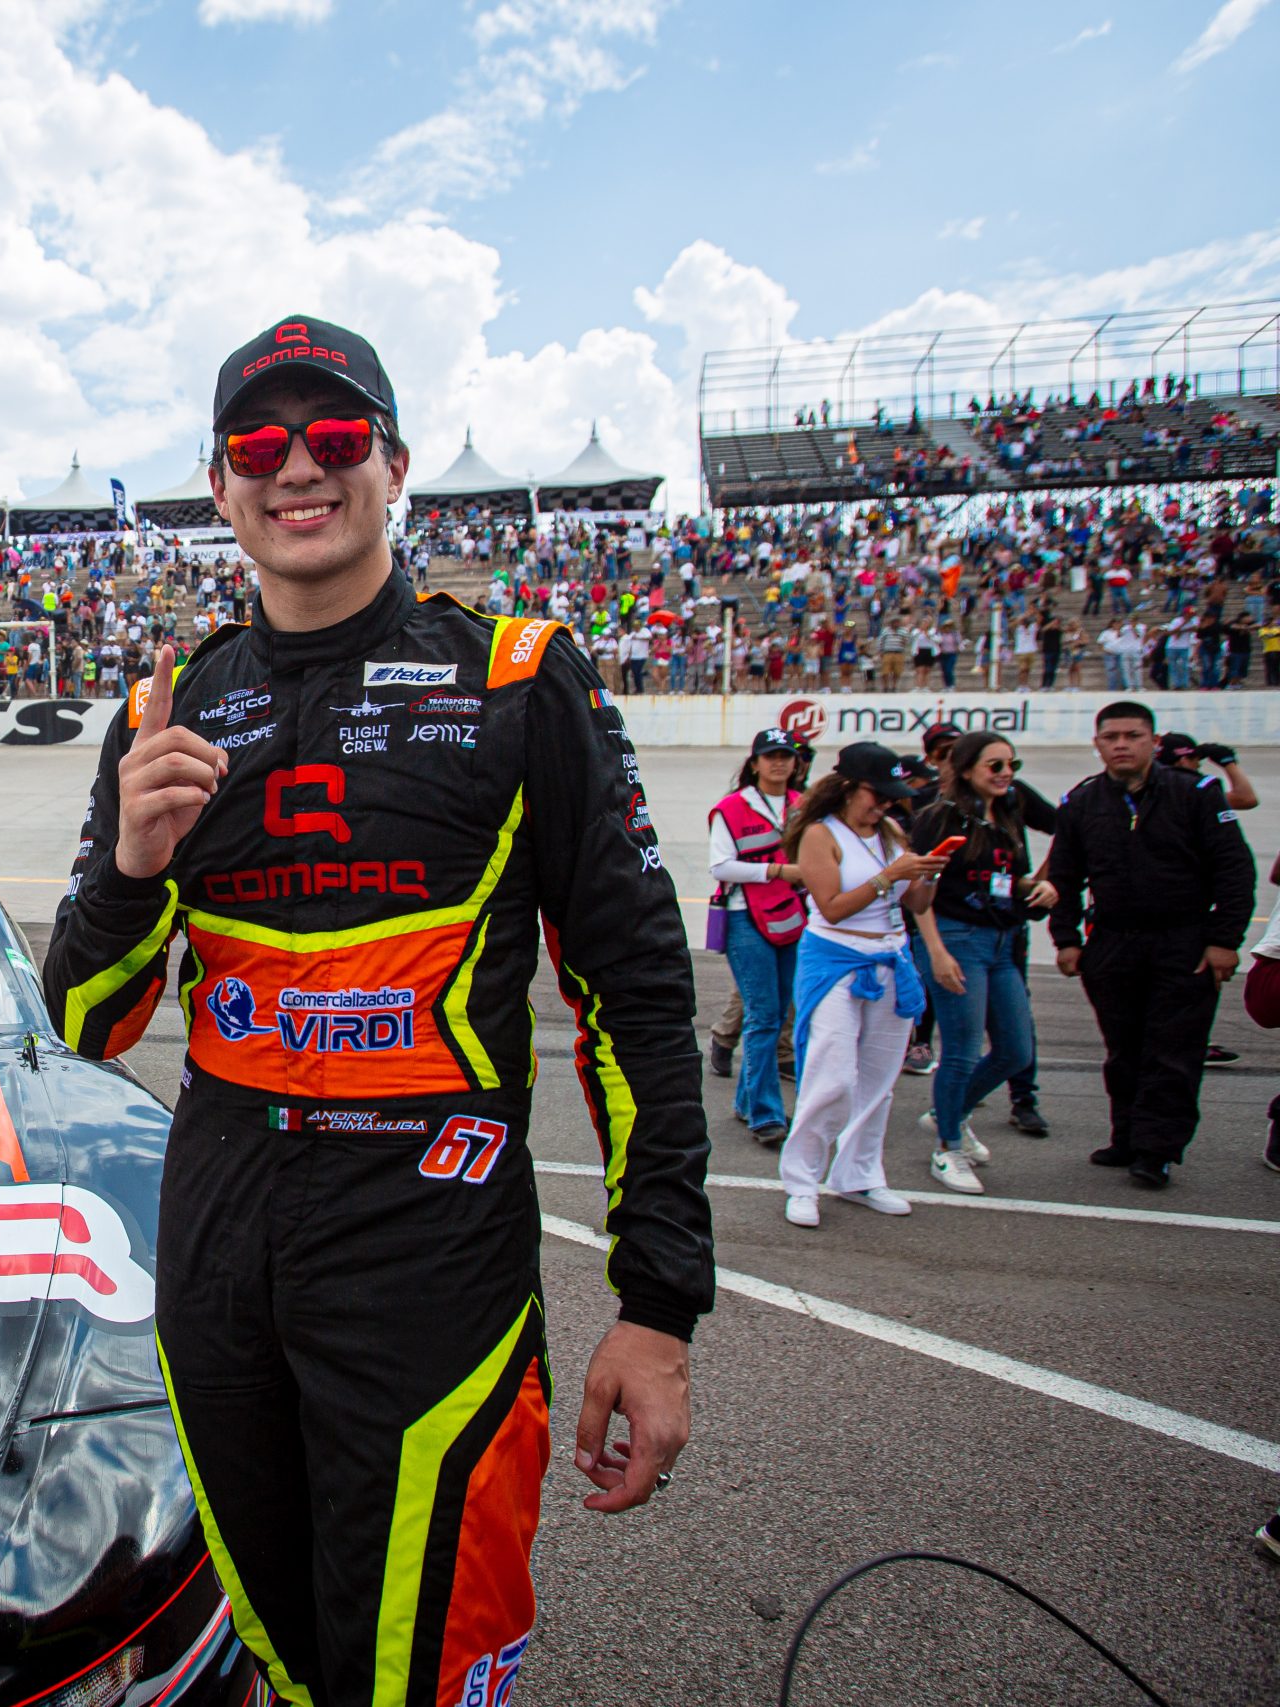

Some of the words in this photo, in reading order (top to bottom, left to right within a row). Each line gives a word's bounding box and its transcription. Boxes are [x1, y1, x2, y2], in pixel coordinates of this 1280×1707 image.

[242, 347, 348, 377] COMPAQ
[389, 667, 453, 682] telcel
[419, 704, 480, 713] DIMAYUGA
[428, 698, 482, 706] TRANSPORTES
[226, 710, 246, 722] SERIES
[839, 700, 1029, 732] maximal
[209, 724, 276, 749] MMSCOPE
[339, 725, 390, 740] FLIGHT
[203, 860, 431, 903] COMPAQ
[280, 987, 412, 1008] Comercializadora
[275, 1010, 415, 1053] VIRDI
[306, 1110, 377, 1122] ANDRIK
[419, 1114, 508, 1184] 67
